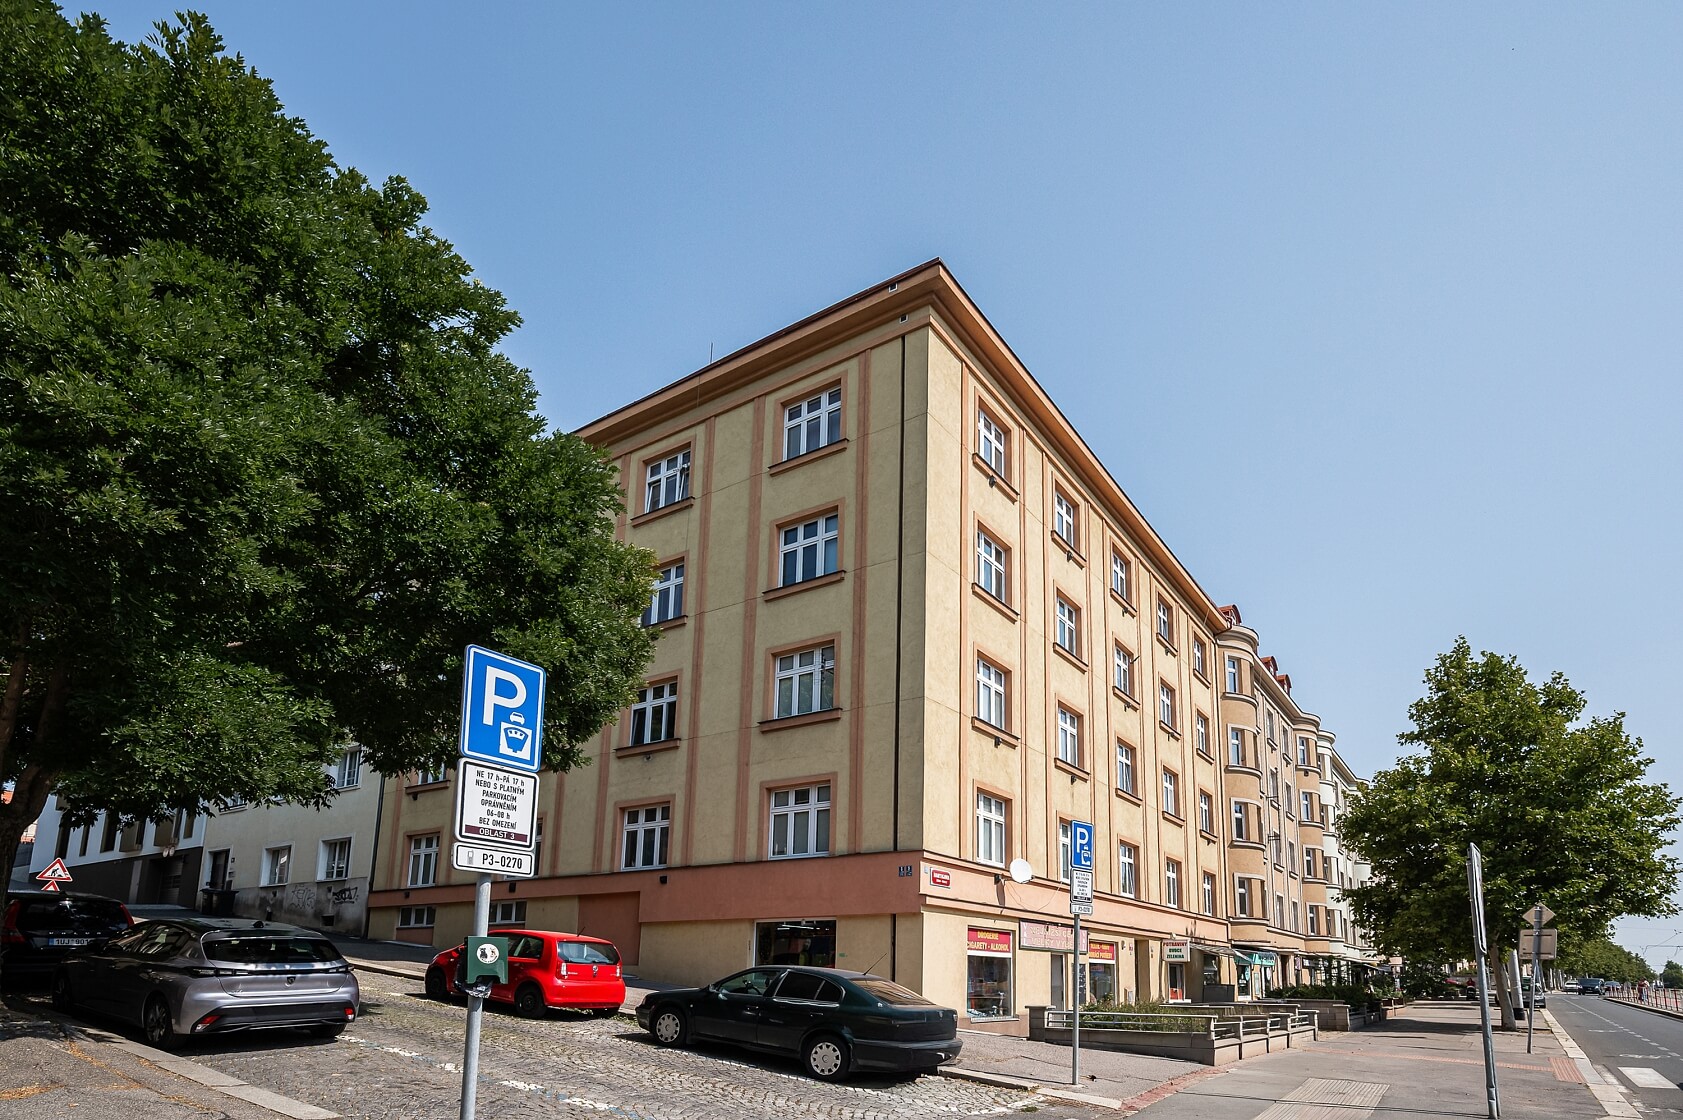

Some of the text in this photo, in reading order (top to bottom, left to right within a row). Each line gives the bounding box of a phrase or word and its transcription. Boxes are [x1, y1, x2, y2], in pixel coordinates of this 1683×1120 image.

[482, 665, 527, 726] P
[476, 769, 485, 778] NE
[476, 778, 491, 789] NEBO
[500, 784, 524, 795] PLATNÝM
[482, 789, 517, 802] PARKOVACÍM
[480, 798, 517, 812] OPRÁVNĚNÍM
[486, 808, 504, 818] 06-08
[479, 816, 516, 830] BEZ OMEZENÍ
[479, 828, 508, 838] OBLAST
[1076, 827, 1089, 854] P
[482, 853, 522, 869] P3-0270
